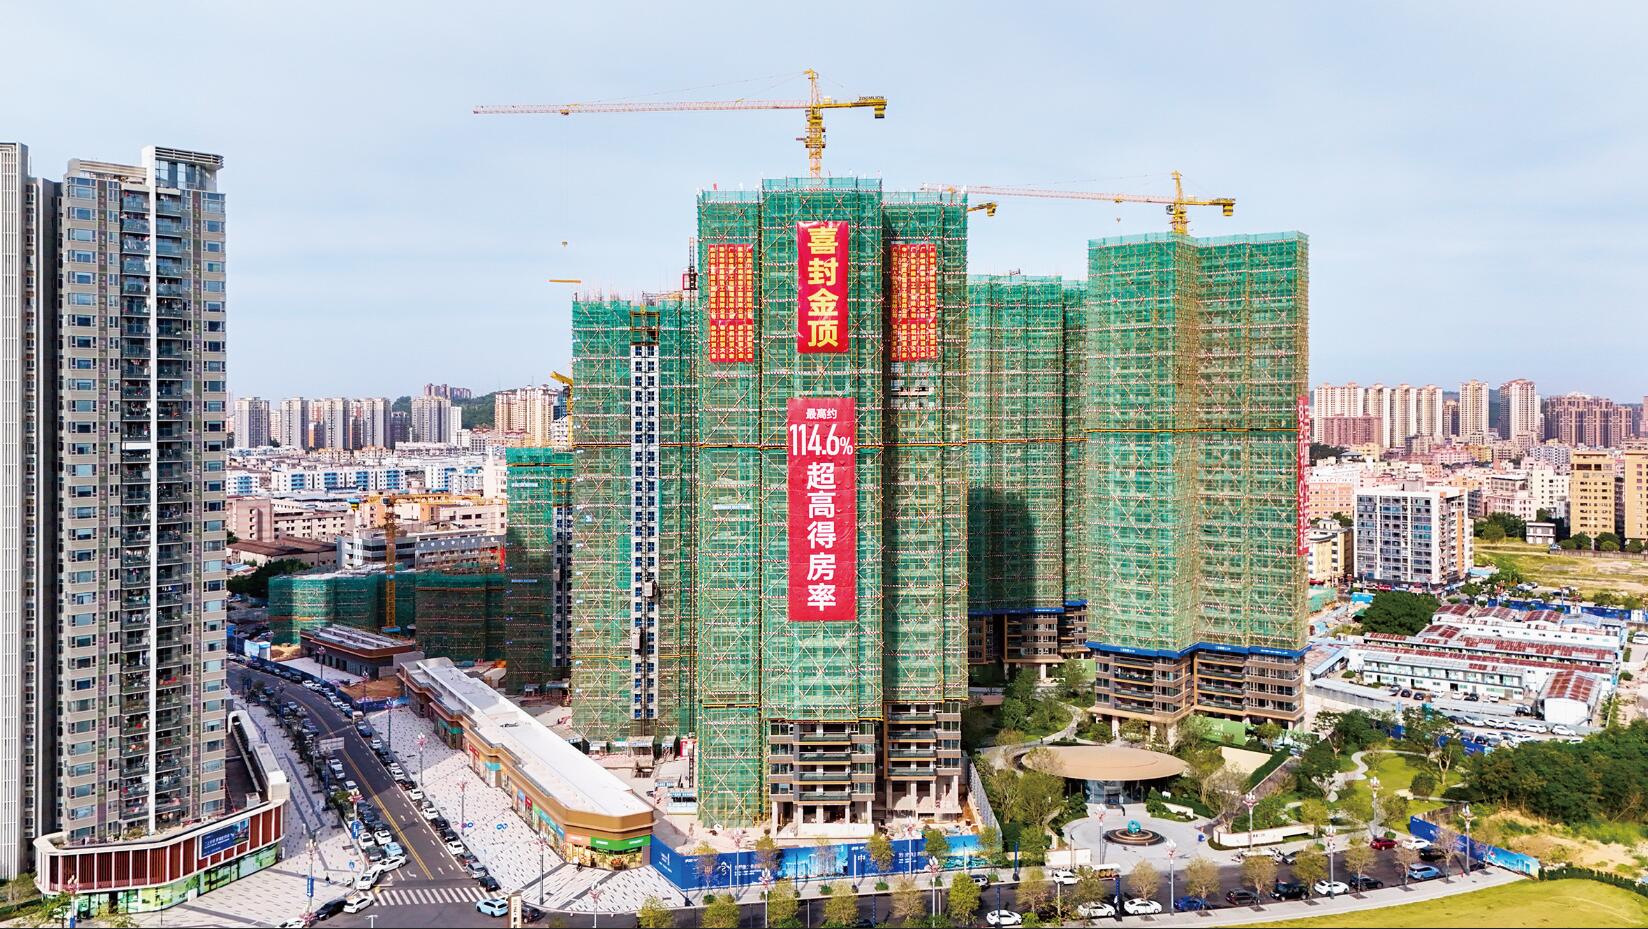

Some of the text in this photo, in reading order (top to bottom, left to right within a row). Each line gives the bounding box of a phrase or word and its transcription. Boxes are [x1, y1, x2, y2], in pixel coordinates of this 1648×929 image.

[807, 227, 839, 348] 喜封金顶
[789, 423, 853, 456] 114.6%
[805, 408, 837, 420] 最高约
[806, 461, 837, 612] 超高得房率
